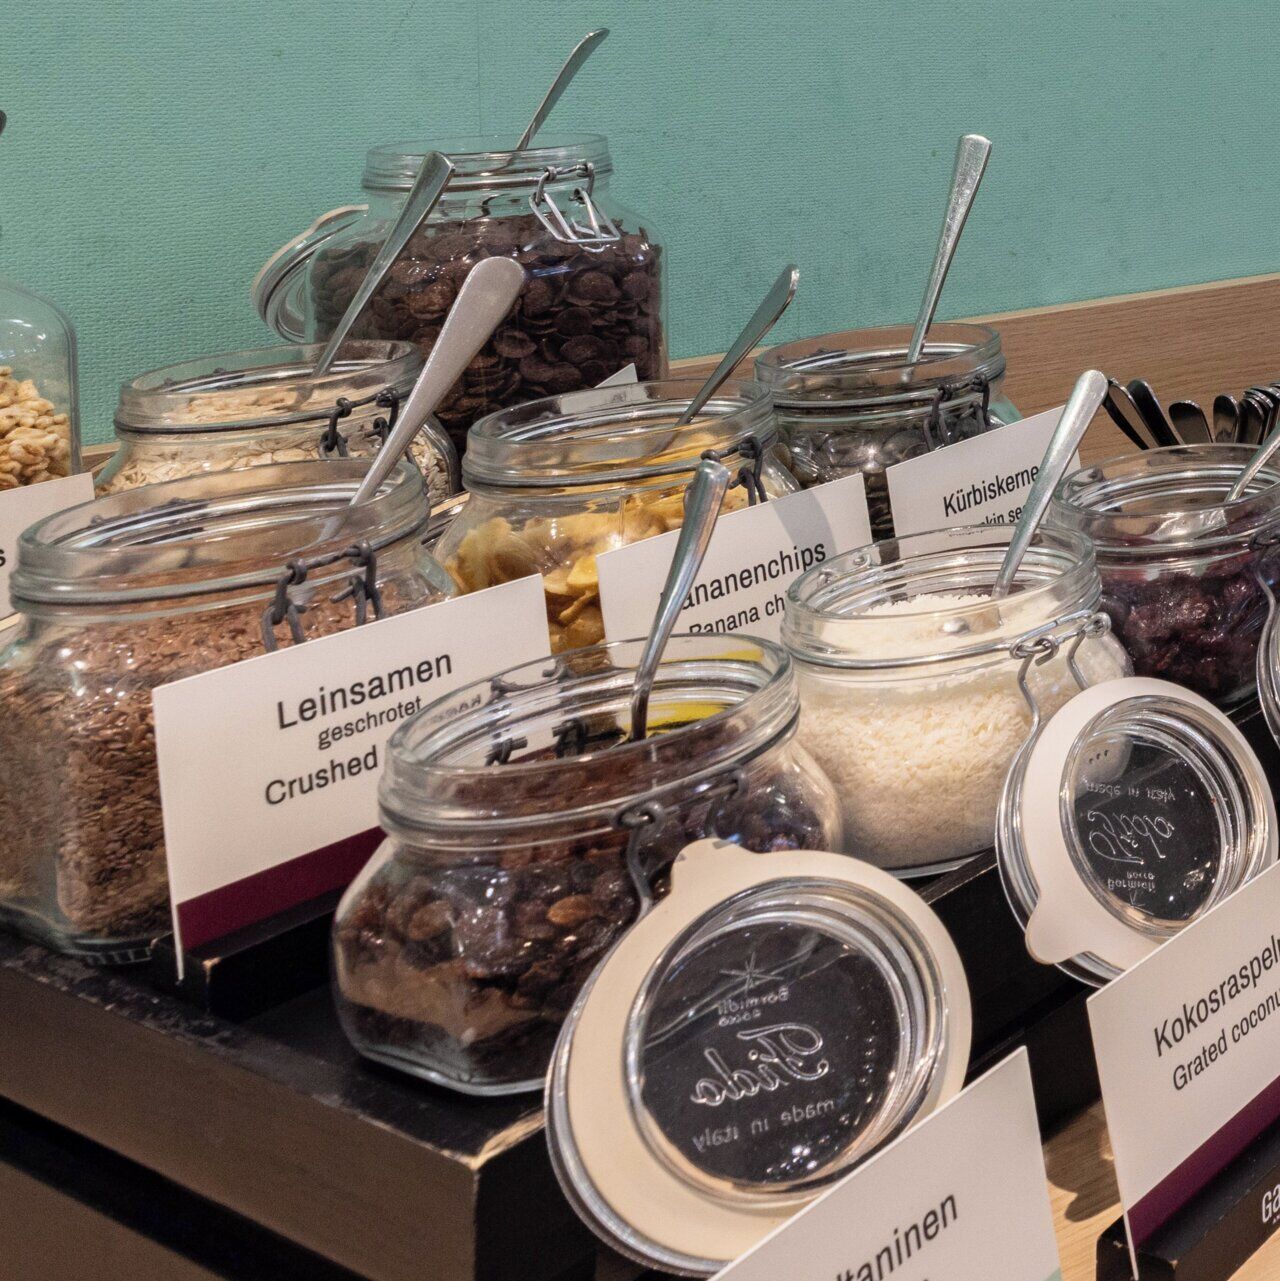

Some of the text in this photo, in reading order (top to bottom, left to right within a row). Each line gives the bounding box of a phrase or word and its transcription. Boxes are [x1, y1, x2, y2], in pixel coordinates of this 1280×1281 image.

[943, 465, 1039, 518] Kürbiskerne
[662, 542, 827, 611] ananenchips
[276, 653, 453, 730] Leinsamen
[317, 695, 423, 751] geschrotet
[265, 744, 379, 805] Crushed
[1172, 1028, 1228, 1091] Grated
[835, 1193, 958, 1281] aninen
